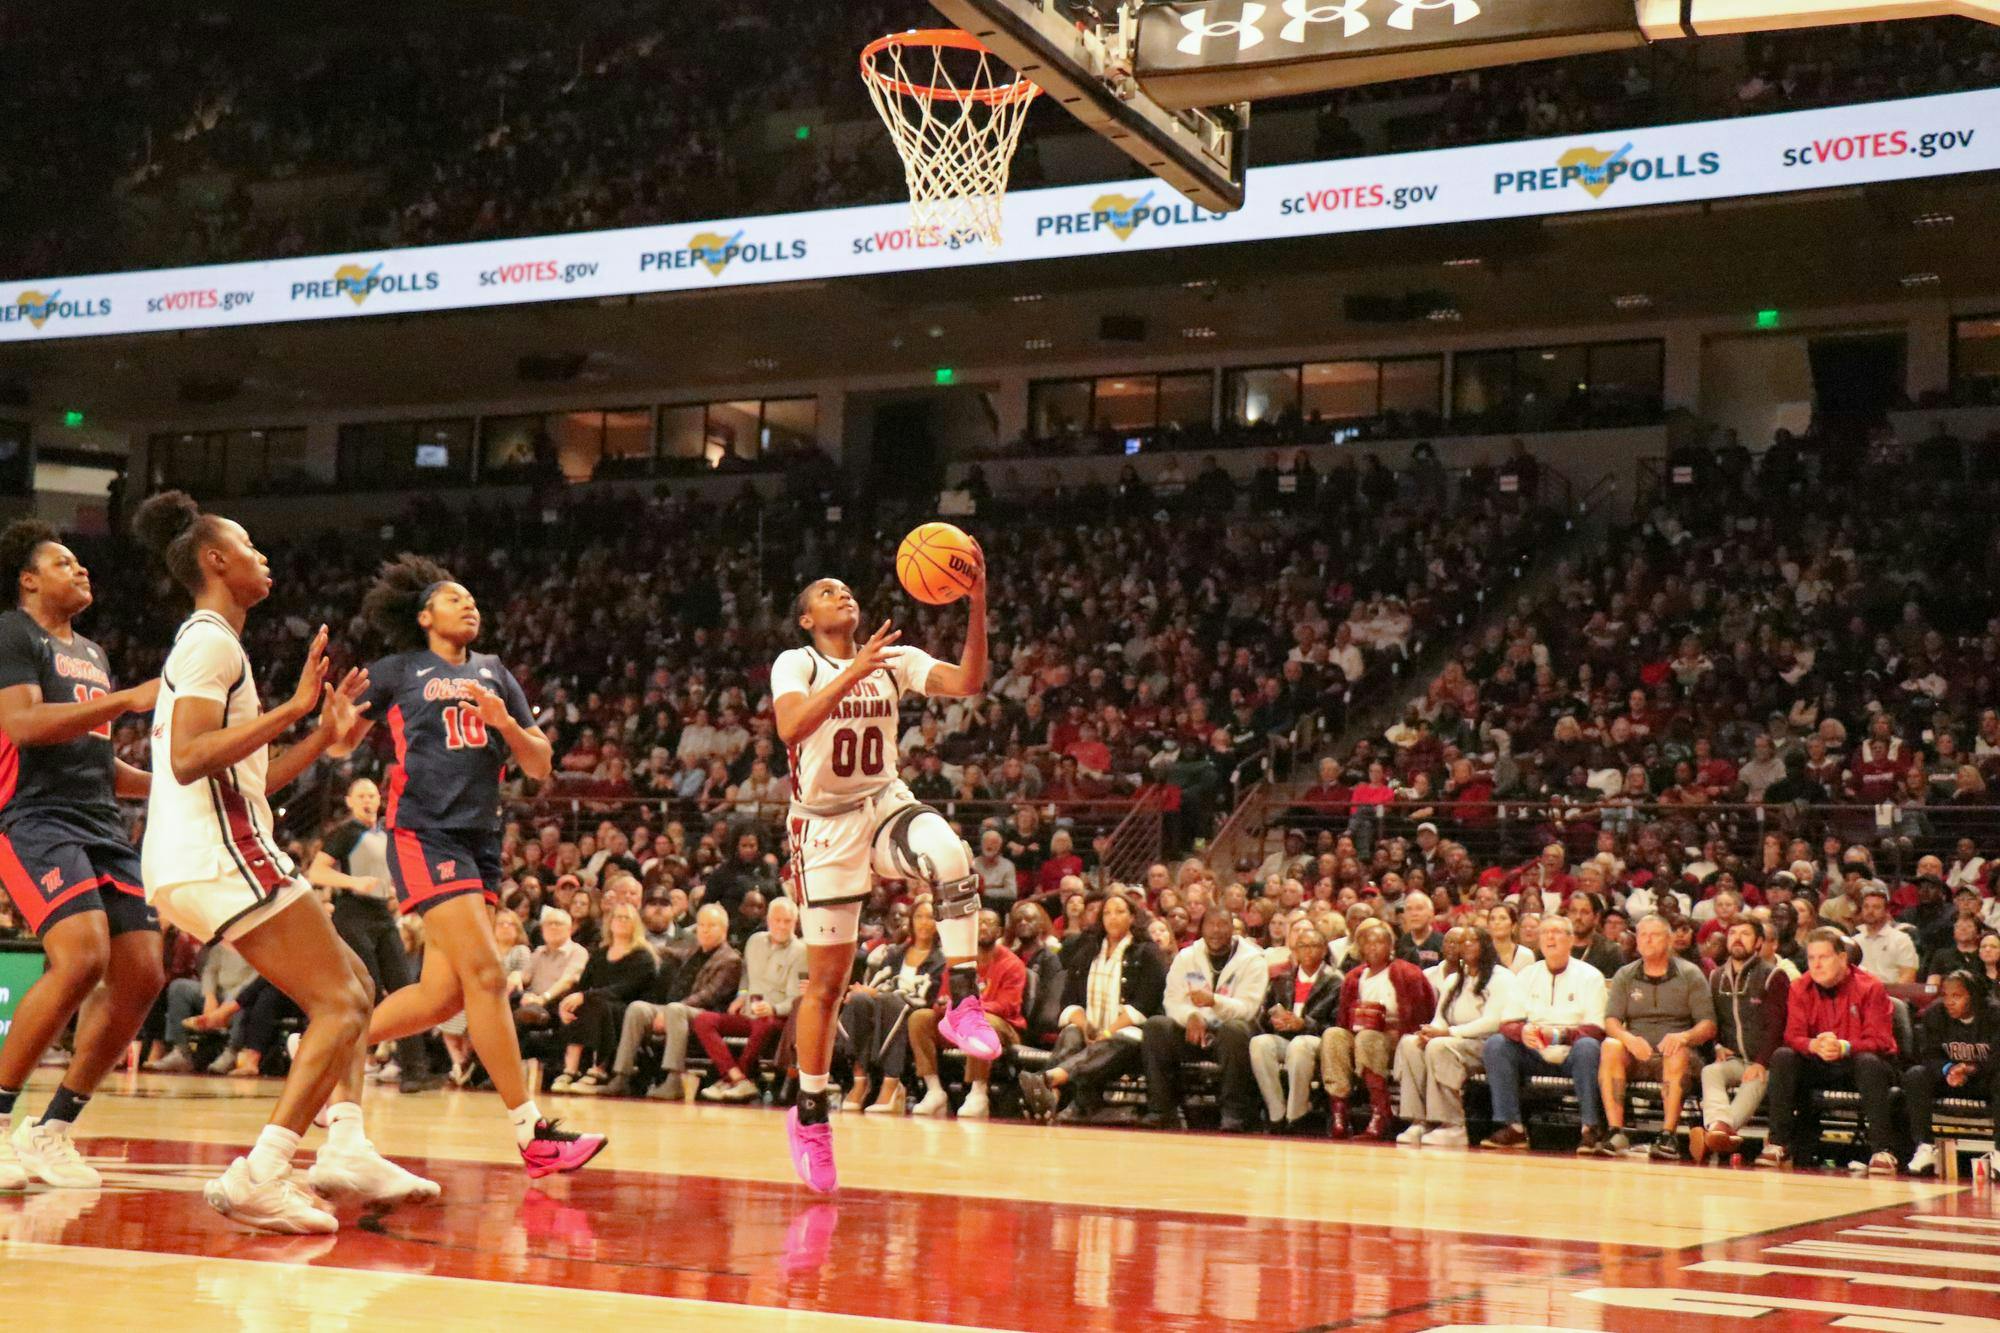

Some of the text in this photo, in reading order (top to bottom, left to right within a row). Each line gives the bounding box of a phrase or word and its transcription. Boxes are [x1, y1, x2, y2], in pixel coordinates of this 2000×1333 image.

[1783, 129, 1975, 167] scVOTES.gov
[1494, 165, 1581, 194] PREP
[1608, 152, 1720, 184] POLLS
[1280, 184, 1438, 215] scVOTES.gov
[1037, 212, 1111, 237] PREP
[640, 239, 807, 271] PREP POLLS
[291, 272, 439, 300] PREP POLLS
[479, 260, 599, 286] scVOTES.gov
[45, 298, 112, 319] POLLS
[147, 289, 254, 312] scVOTES.gov
[826, 700, 892, 719] AROLINA
[442, 706, 488, 750] 10
[832, 726, 884, 777] 00
